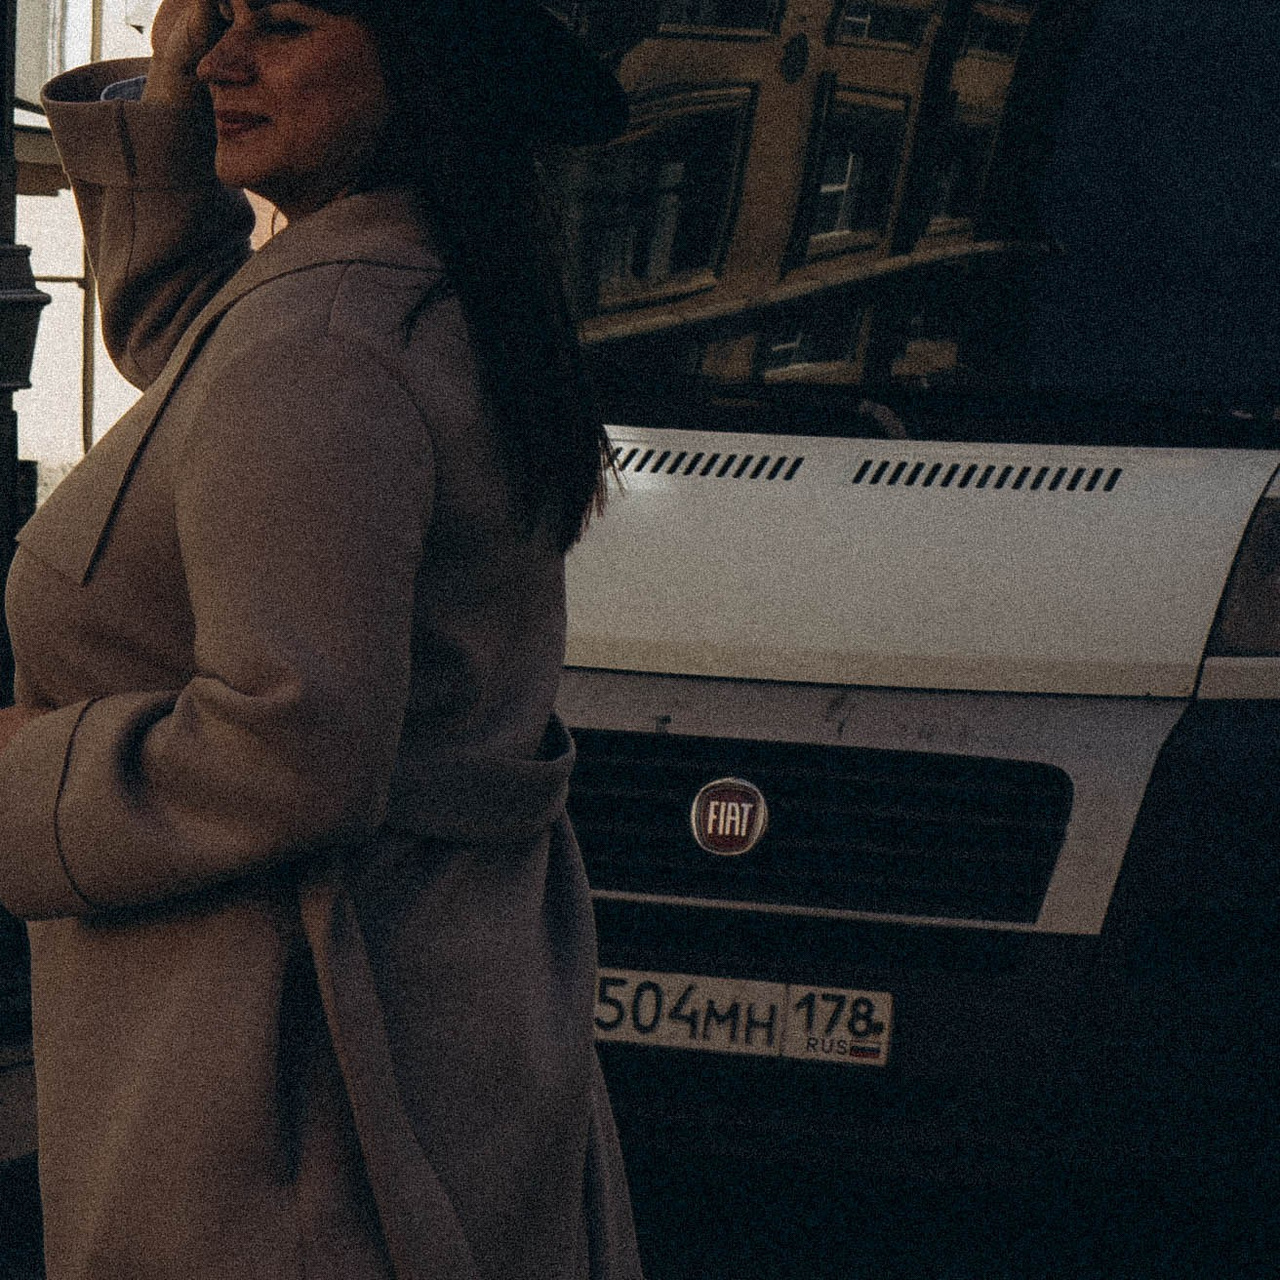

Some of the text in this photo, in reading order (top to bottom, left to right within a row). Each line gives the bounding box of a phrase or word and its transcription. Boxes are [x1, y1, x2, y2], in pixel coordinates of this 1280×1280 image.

[707, 800, 754, 837] FIAT
[795, 991, 876, 1039] 178
[806, 1037, 848, 1056] RUS
